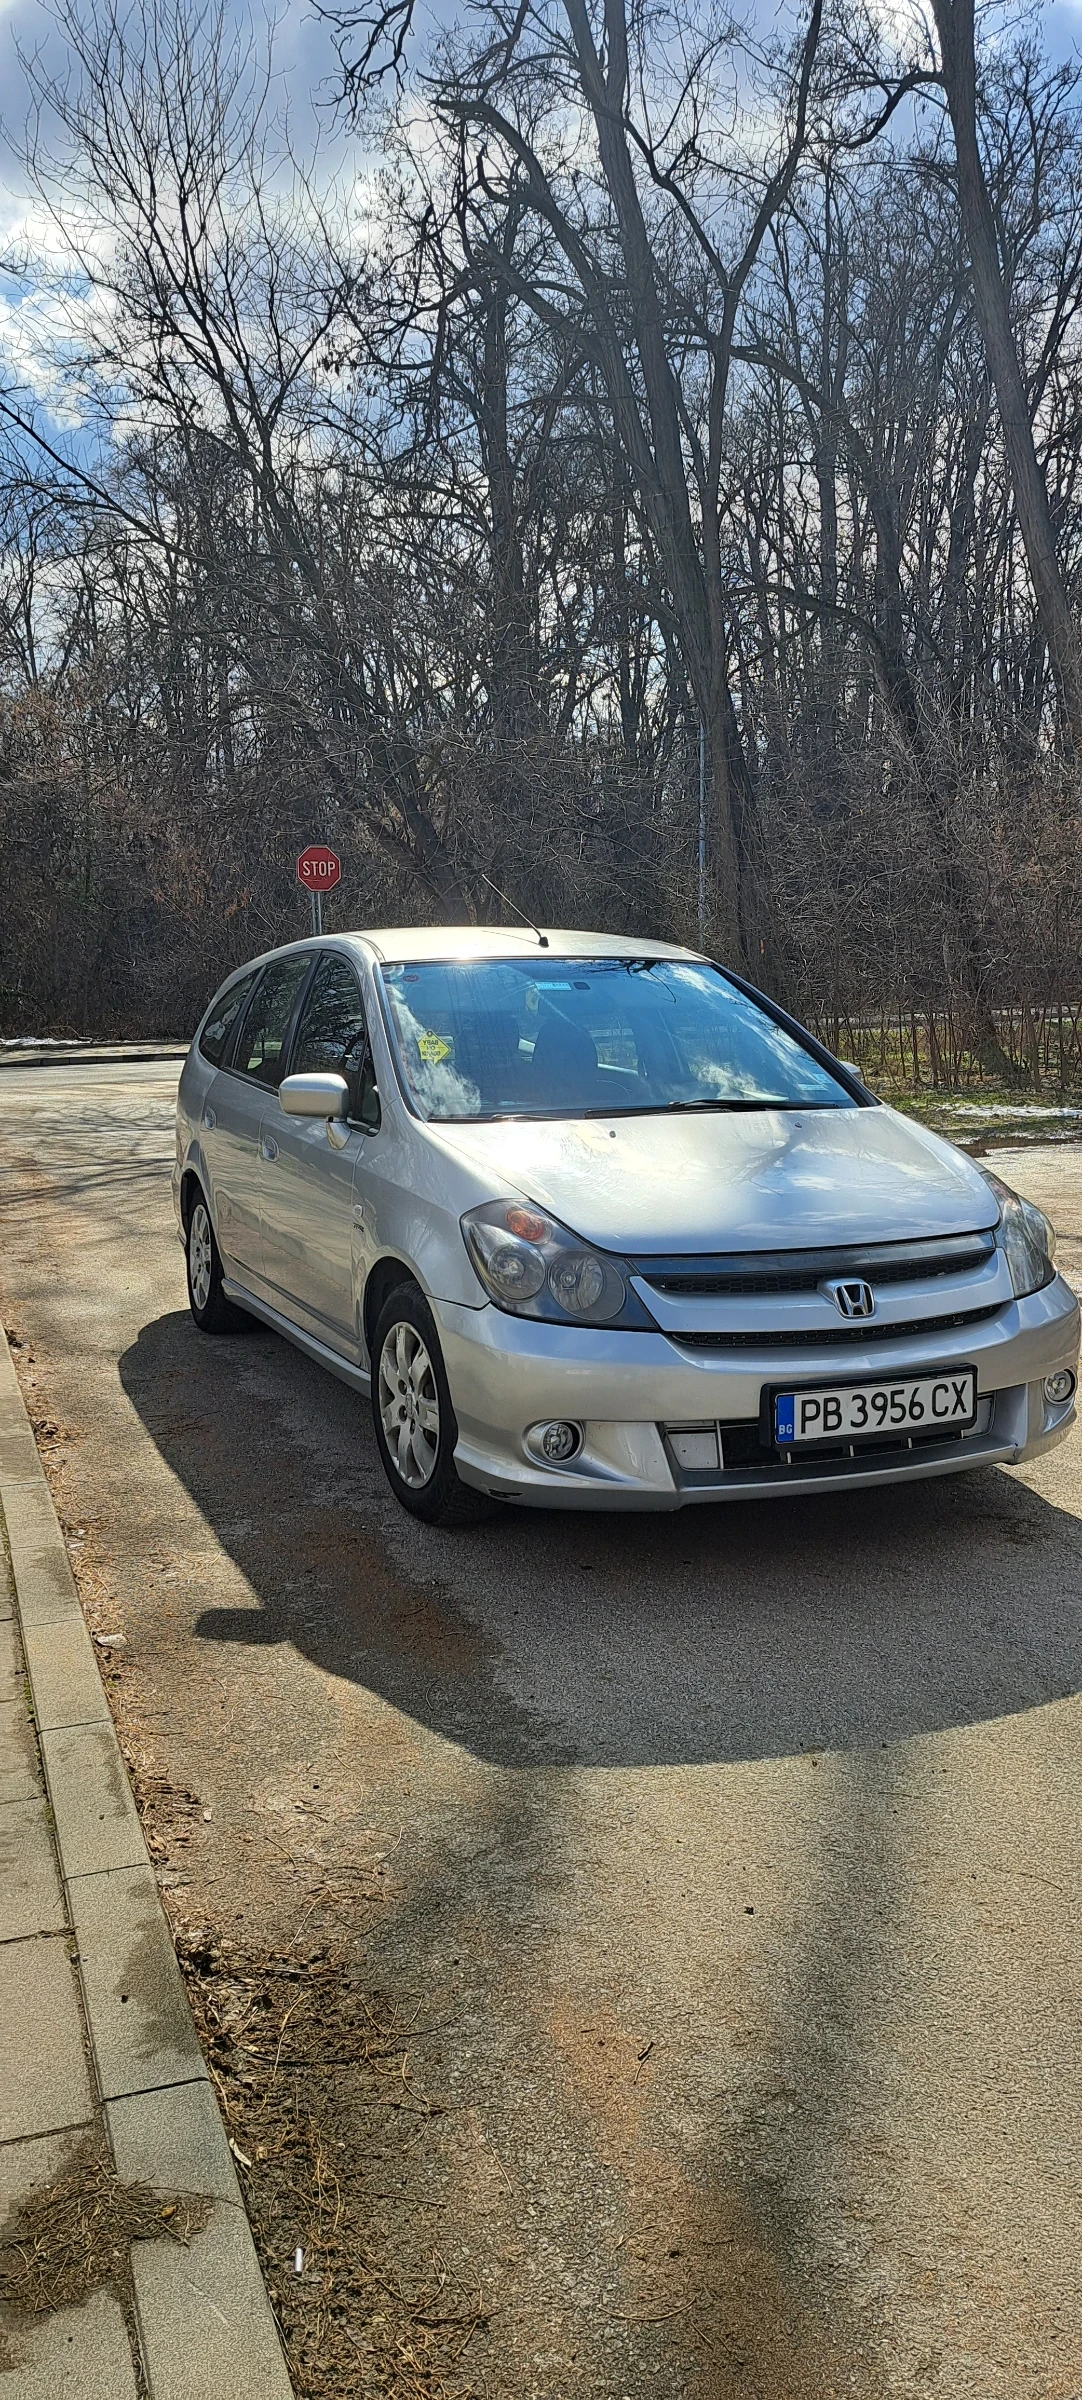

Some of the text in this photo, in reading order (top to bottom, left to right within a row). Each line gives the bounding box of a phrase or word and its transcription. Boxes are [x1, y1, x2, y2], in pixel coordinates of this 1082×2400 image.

[302, 860, 336, 877] STOP
[800, 1379, 968, 1434] PB 3956 CX
[778, 1423, 793, 1435] BG
